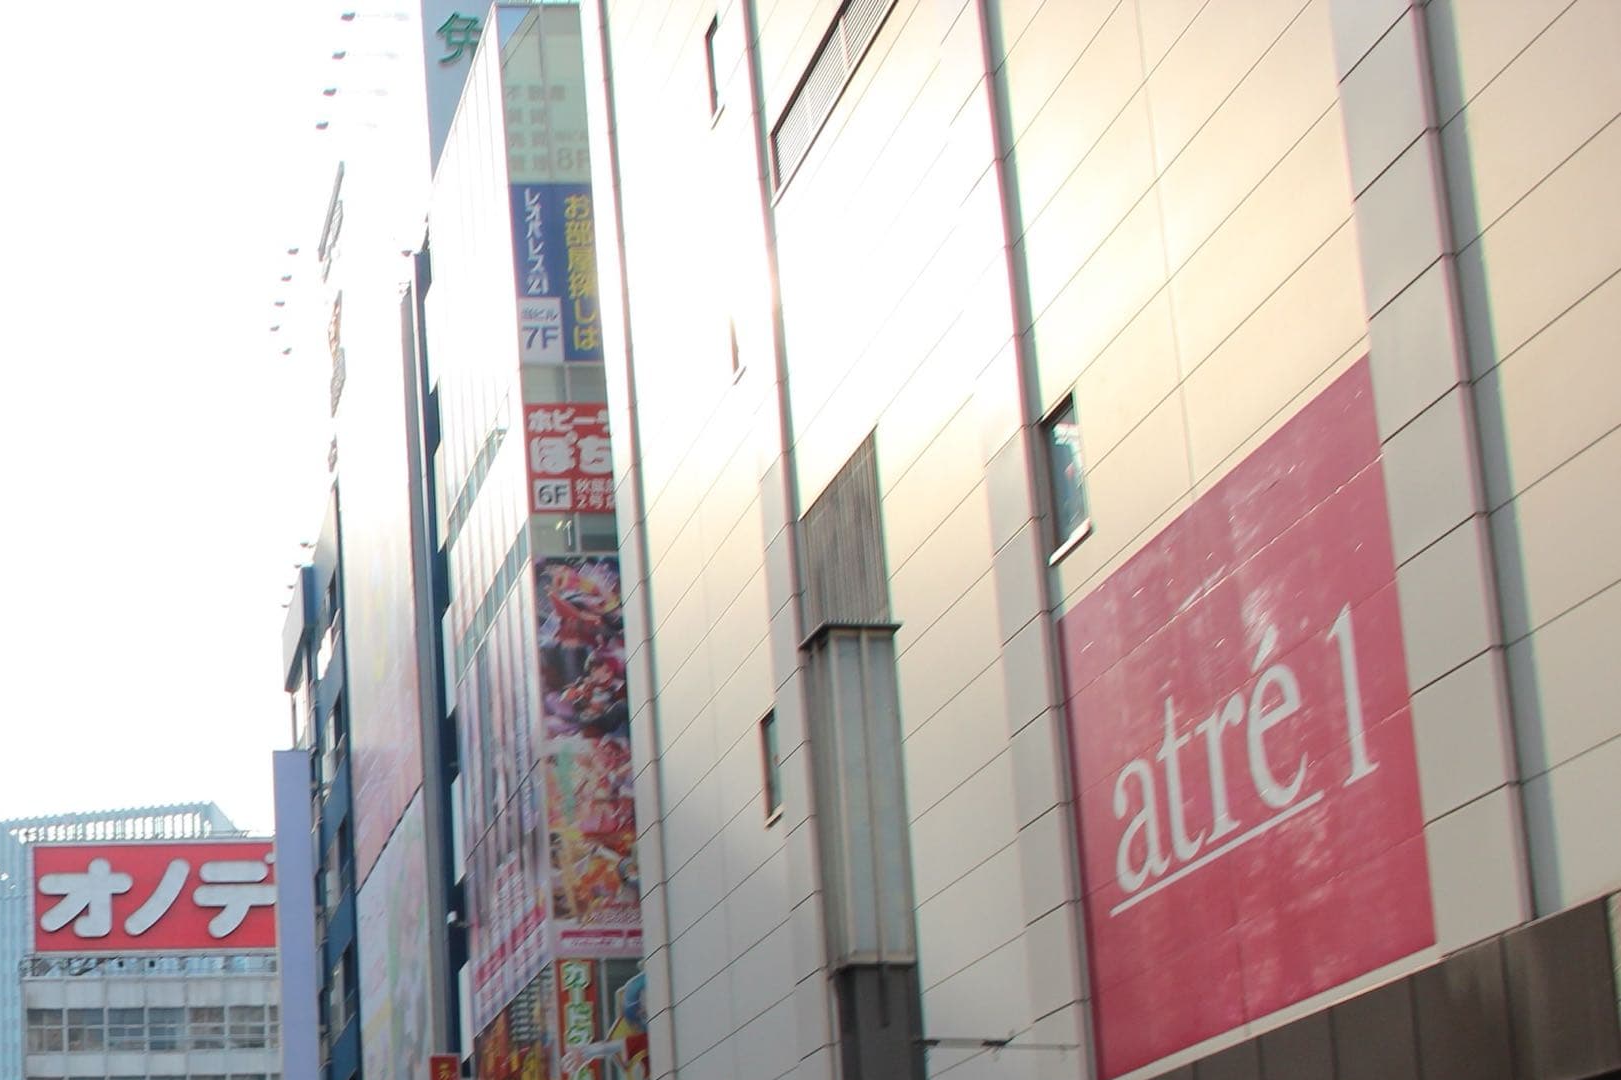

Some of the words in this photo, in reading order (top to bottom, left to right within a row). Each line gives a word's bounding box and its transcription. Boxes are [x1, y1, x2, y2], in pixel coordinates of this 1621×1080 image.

[522, 326, 559, 350] 7F
[538, 484, 568, 504] 6F
[1325, 601, 1381, 788] 1
